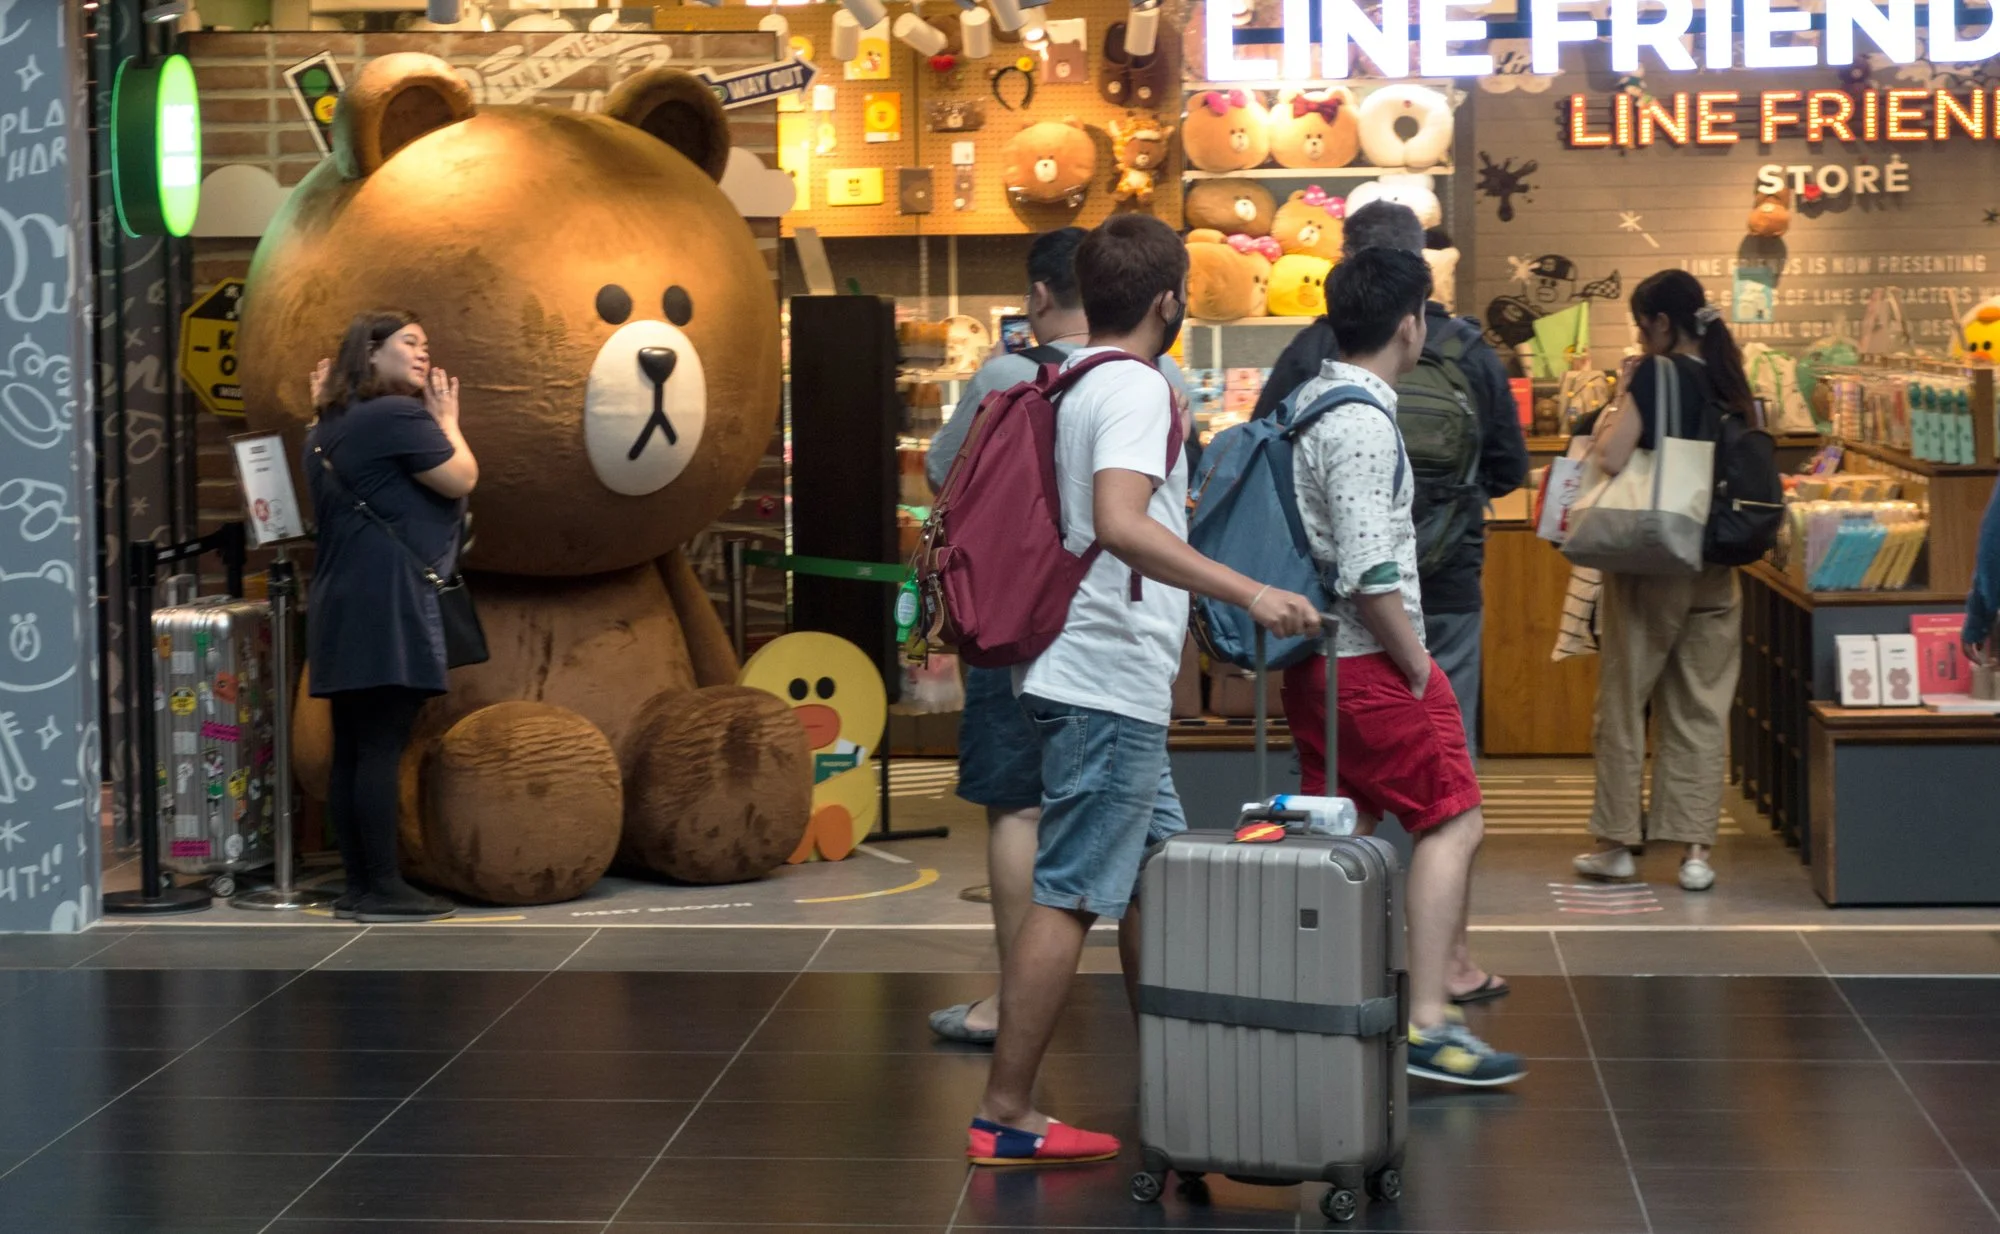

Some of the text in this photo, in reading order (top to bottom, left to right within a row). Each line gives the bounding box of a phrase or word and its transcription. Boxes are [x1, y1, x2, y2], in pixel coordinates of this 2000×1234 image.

[1206, 0, 2000, 80] LINE FRIEND
[726, 65, 804, 100] WAY OUT
[0, 98, 66, 157] PLA
[1570, 89, 2000, 147] LINE FRIEN
[6, 136, 68, 182] HAR
[1757, 162, 1911, 195] STORE
[1681, 258, 1721, 276] LINE
[1807, 257, 1827, 275] IS
[1832, 256, 1871, 274] NOW
[1878, 254, 1987, 273] PRESENTING
